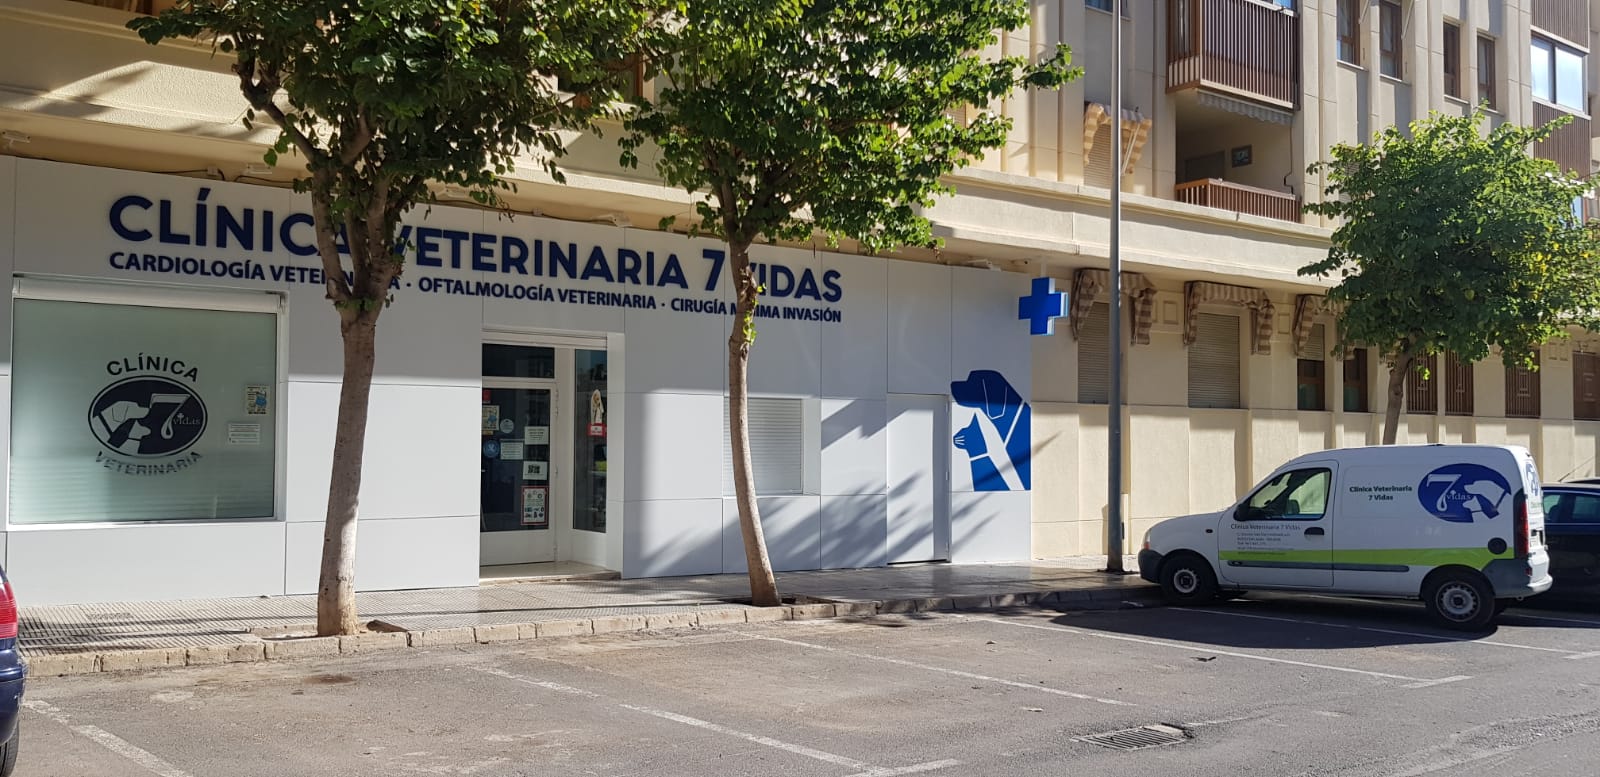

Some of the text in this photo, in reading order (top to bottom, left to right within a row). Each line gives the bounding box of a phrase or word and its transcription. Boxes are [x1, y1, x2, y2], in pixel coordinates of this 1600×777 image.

[109, 251, 842, 323] CARDIOLOGÍA VETENA OFTALMOLOGÍA VETERINARIA CIRUGÍA MIMA INVASIÓN
[702, 248, 726, 292] 7
[750, 262, 843, 303] IDAS
[106, 352, 199, 382] CLÍNICA
[150, 393, 193, 439] 7
[96, 451, 203, 476] VETERINARIA
[1426, 474, 1472, 512] 7 vidas
